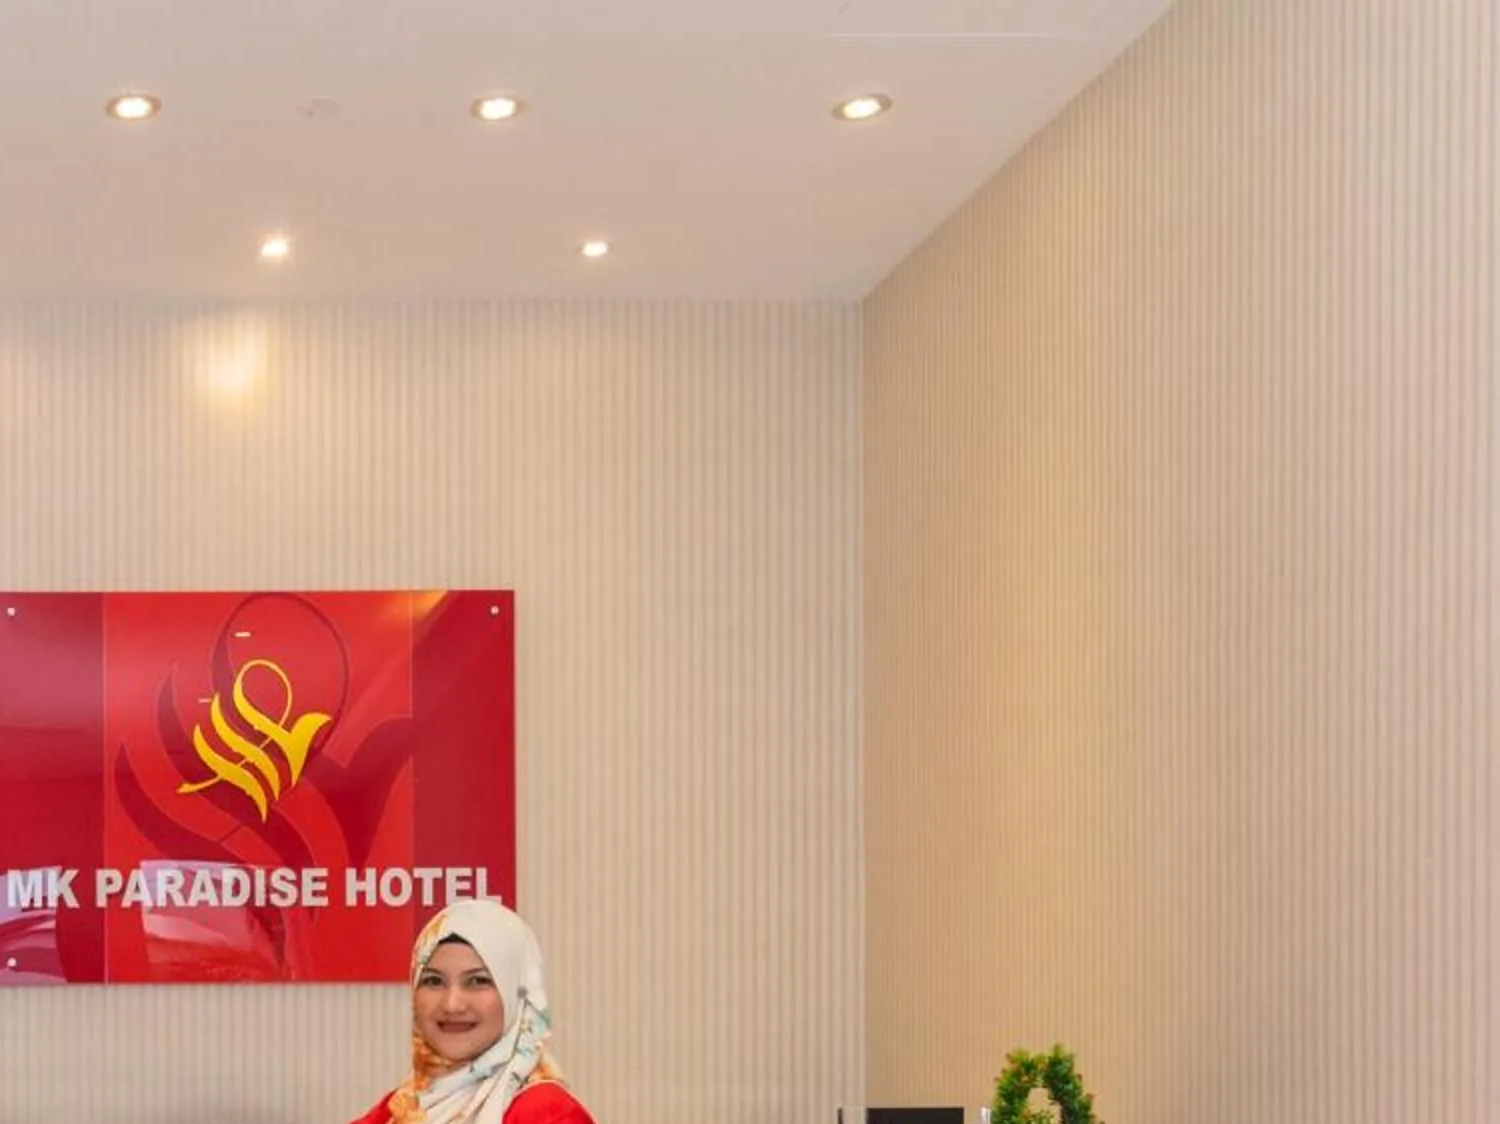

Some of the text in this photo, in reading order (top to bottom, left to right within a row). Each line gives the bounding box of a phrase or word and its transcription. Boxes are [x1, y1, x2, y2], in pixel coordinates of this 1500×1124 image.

[7, 866, 502, 908] MK PARADISE HOTEL
